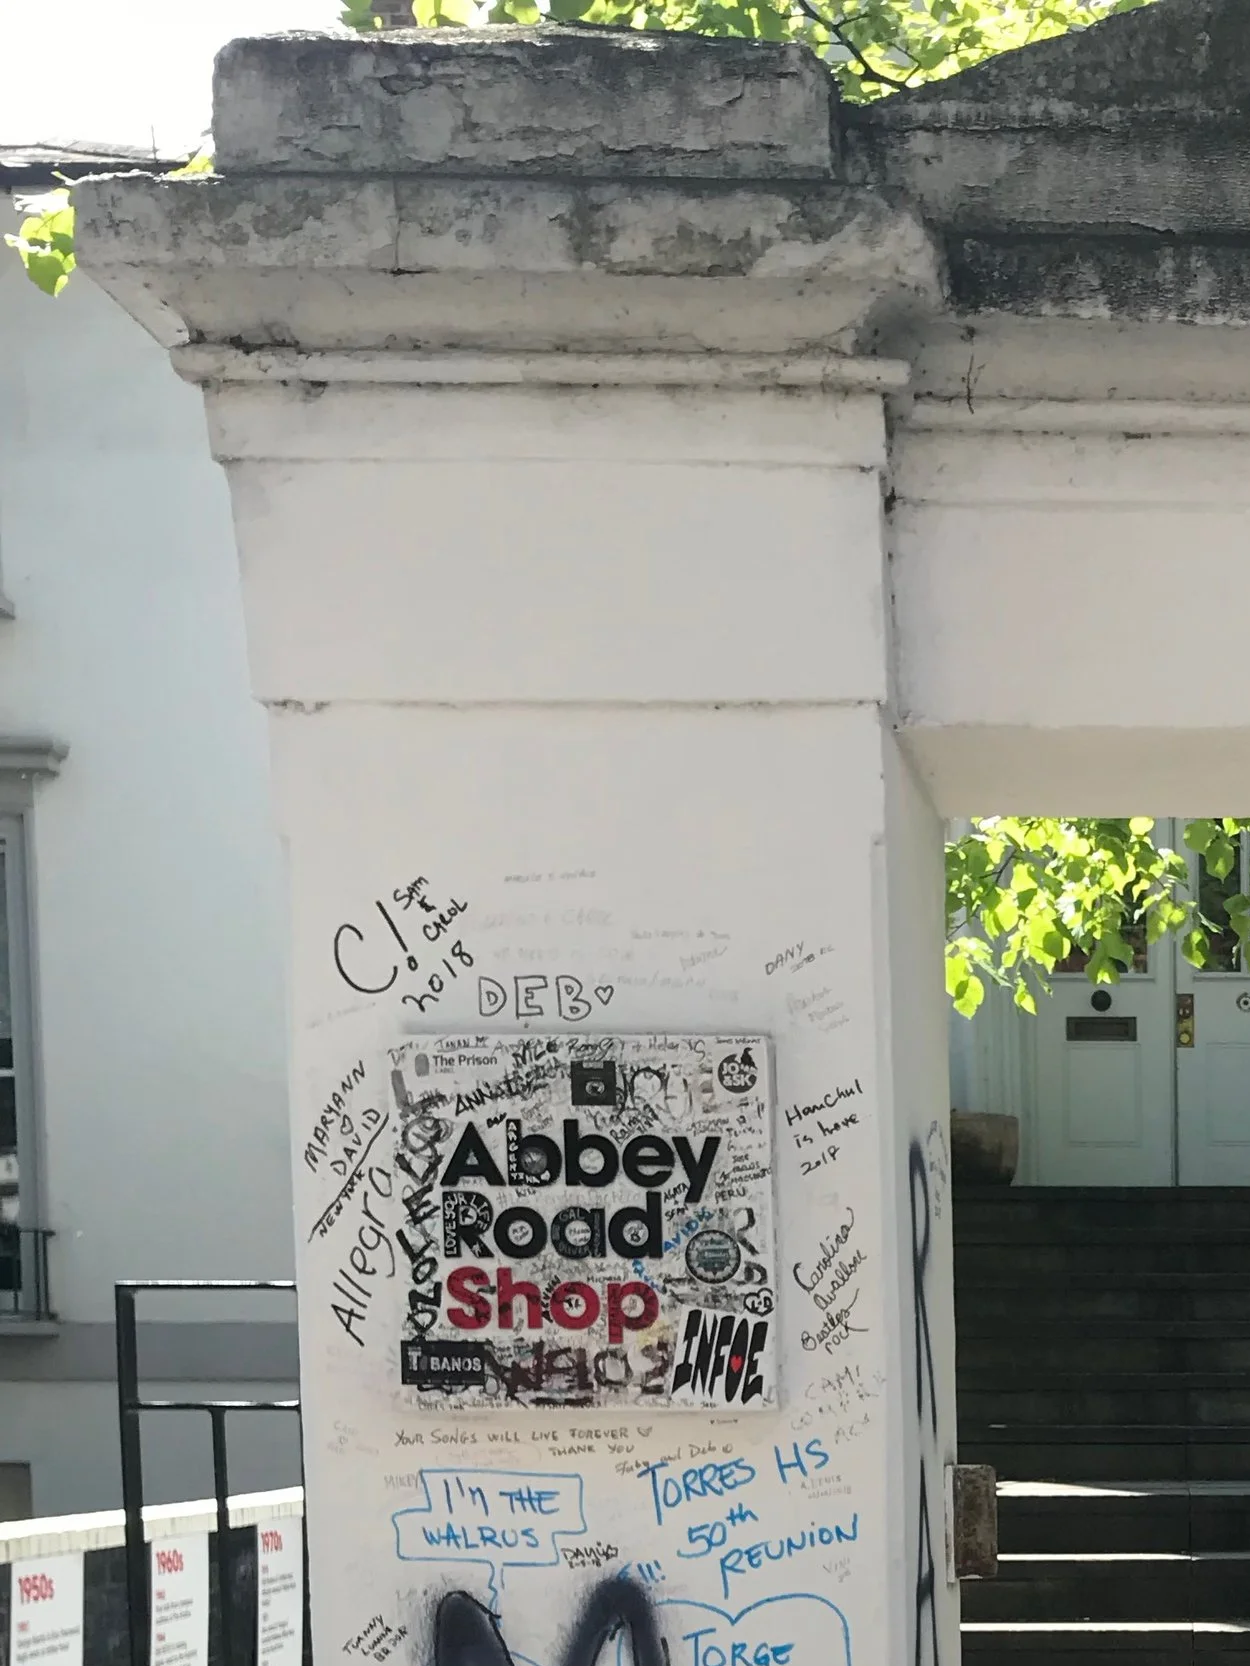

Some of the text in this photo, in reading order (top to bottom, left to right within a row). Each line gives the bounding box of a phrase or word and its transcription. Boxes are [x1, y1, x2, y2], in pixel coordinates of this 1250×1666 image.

[478, 975, 593, 1022] DEB
[432, 1054, 498, 1067] The Prison
[440, 1118, 722, 1203] Abbey
[442, 1190, 664, 1260] Road
[446, 1265, 660, 1344] Shop
[488, 1431, 521, 1443] WILL
[531, 1430, 558, 1441] LIVE
[547, 1443, 635, 1457] THANK YOU
[637, 1457, 756, 1526] TORRES
[774, 1439, 829, 1484] HS
[498, 1486, 560, 1515] THE
[260, 1530, 283, 1556] 1970s
[423, 1522, 540, 1550] WALRUS
[677, 1503, 759, 1558] 50th
[156, 1549, 184, 1575] 1960s
[18, 1573, 55, 1606] 1950s
